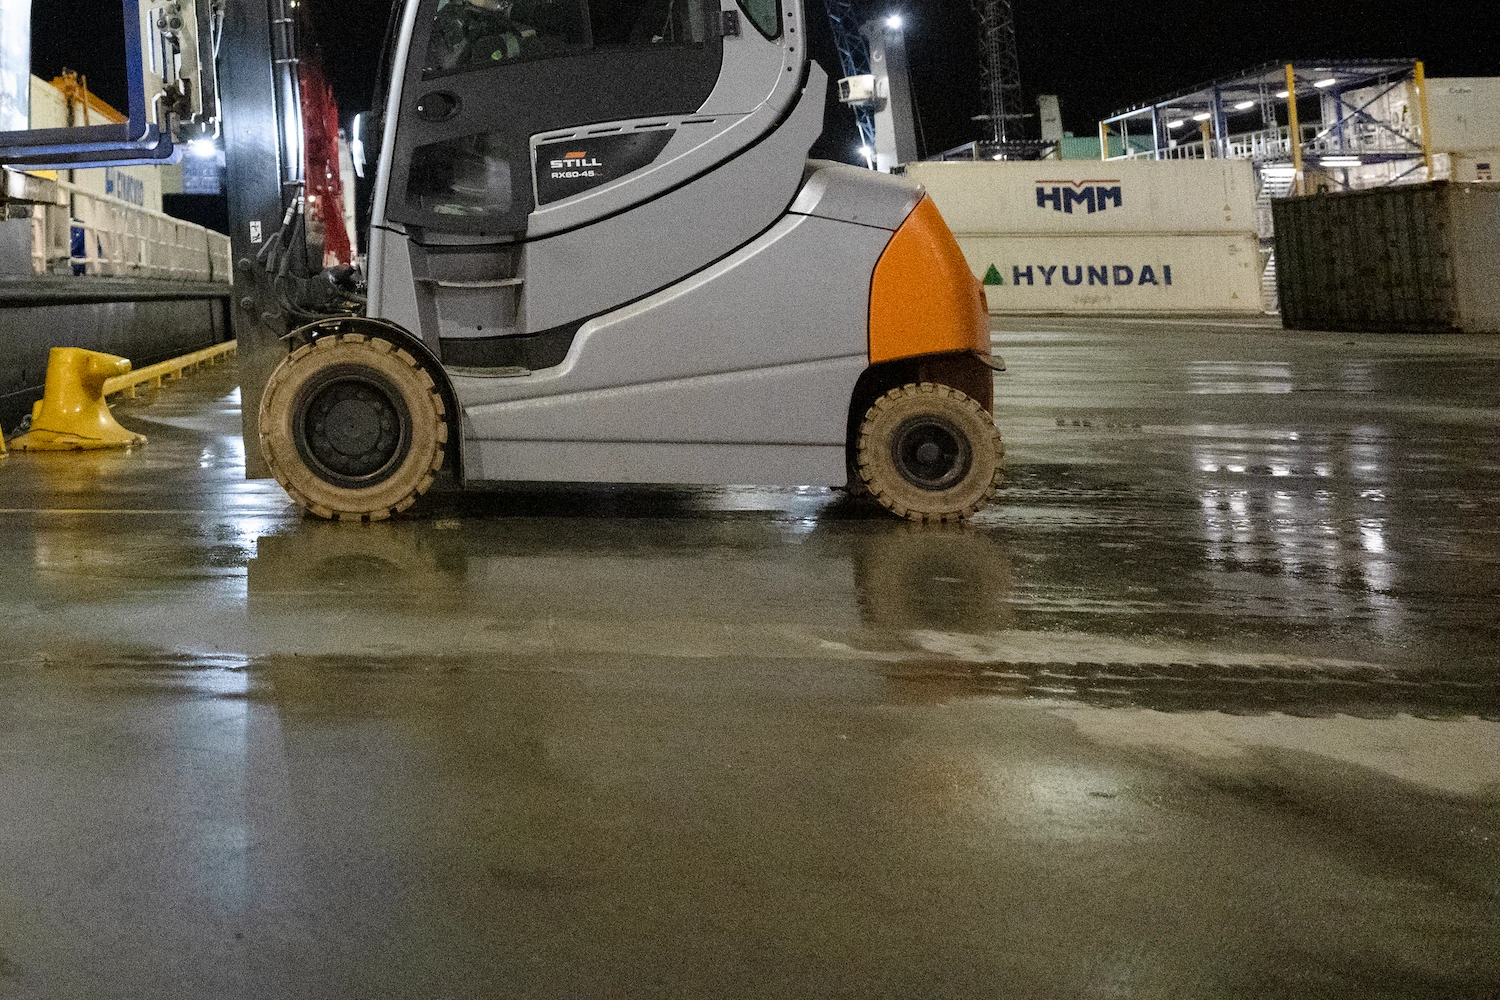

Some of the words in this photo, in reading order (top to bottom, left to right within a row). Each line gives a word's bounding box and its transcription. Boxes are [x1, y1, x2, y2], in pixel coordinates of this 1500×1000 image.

[550, 158, 603, 169] STILL
[1036, 183, 1122, 214] HMM
[1013, 264, 1173, 287] HYUNDAI
